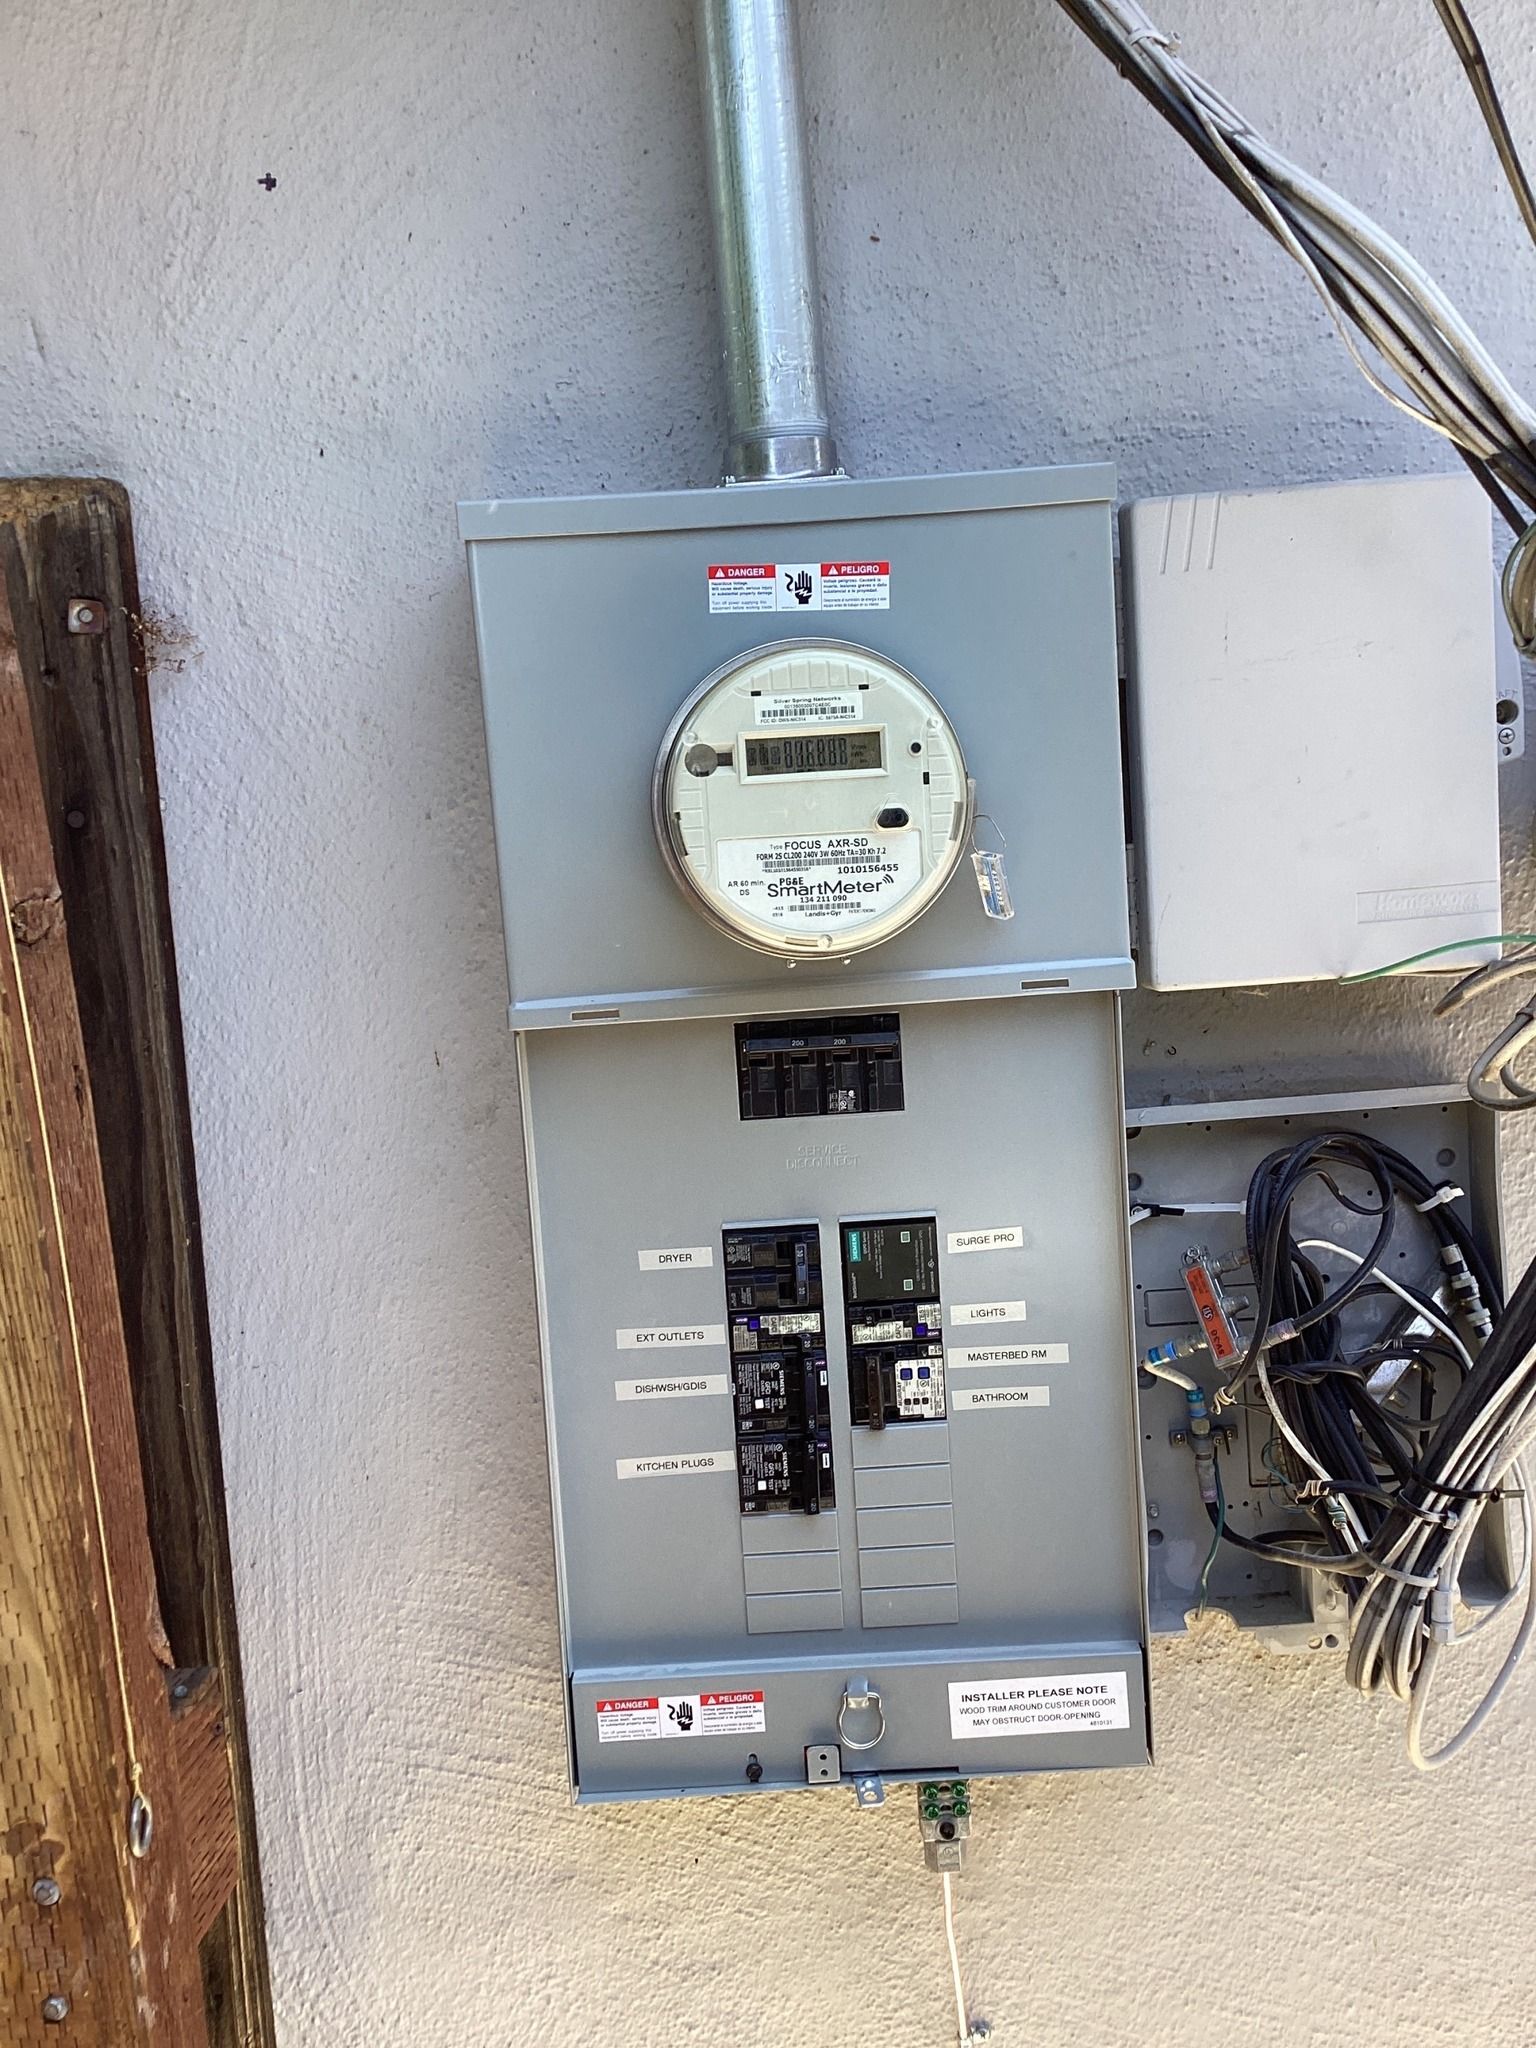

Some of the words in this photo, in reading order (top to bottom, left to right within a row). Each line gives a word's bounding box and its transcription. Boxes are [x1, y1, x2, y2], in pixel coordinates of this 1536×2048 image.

[728, 568, 765, 577] DANGER
[841, 565, 879, 574] PELIGRO
[784, 840, 821, 850] FOCUS
[828, 838, 868, 848] AXR-SD
[783, 851, 802, 860] CL200
[803, 850, 818, 858] 240V
[820, 850, 829, 858] 3W
[830, 849, 846, 857] 60Hz
[847, 848, 867, 856] TA=30
[867, 847, 875, 855] Kh
[877, 847, 886, 855] 7.2
[838, 864, 899, 874] 1010156455
[779, 877, 804, 886] PG&E
[767, 880, 882, 898] SmartMeter
[832, 894, 847, 902] 090
[791, 1039, 804, 1047] 200
[798, 1144, 847, 1157] SERVICE
[785, 1153, 859, 1170] DISCONNECT
[956, 1235, 990, 1247] SURGE
[993, 1233, 1015, 1243] PRO
[851, 1233, 859, 1260] SIEMENS
[659, 1253, 693, 1264] DRYER
[970, 1307, 1006, 1318] LIGHTS
[636, 1333, 654, 1343] EXT
[658, 1331, 704, 1341] OUTLETS
[804, 1340, 811, 1348] 20
[967, 1350, 1029, 1361] MASTERBED
[1031, 1349, 1047, 1358] RM
[806, 1361, 813, 1370] 20
[635, 1381, 707, 1394] DISHWSH/GDIS
[972, 1392, 1029, 1403] BATHROOM
[808, 1419, 815, 1428] 20
[636, 1461, 679, 1472] KITCHEN
[681, 1457, 714, 1468] PLUGS
[810, 1503, 817, 1512] 20
[718, 1694, 754, 1703] PELIGRO
[961, 1690, 1025, 1703] INSTALLER
[1028, 1687, 1073, 1698] PLEASE
[1076, 1685, 1108, 1695] NOTE
[614, 1701, 649, 1710] DANGER
[959, 1706, 985, 1715] WOOD
[987, 1705, 1007, 1713] TRIM
[1008, 1703, 1043, 1712] AROUND
[1044, 1699, 1090, 1710] CUSTOMER
[1092, 1698, 1116, 1706] DOOR
[972, 1718, 990, 1727] MAY
[992, 1715, 1035, 1725] OBSTRUCT
